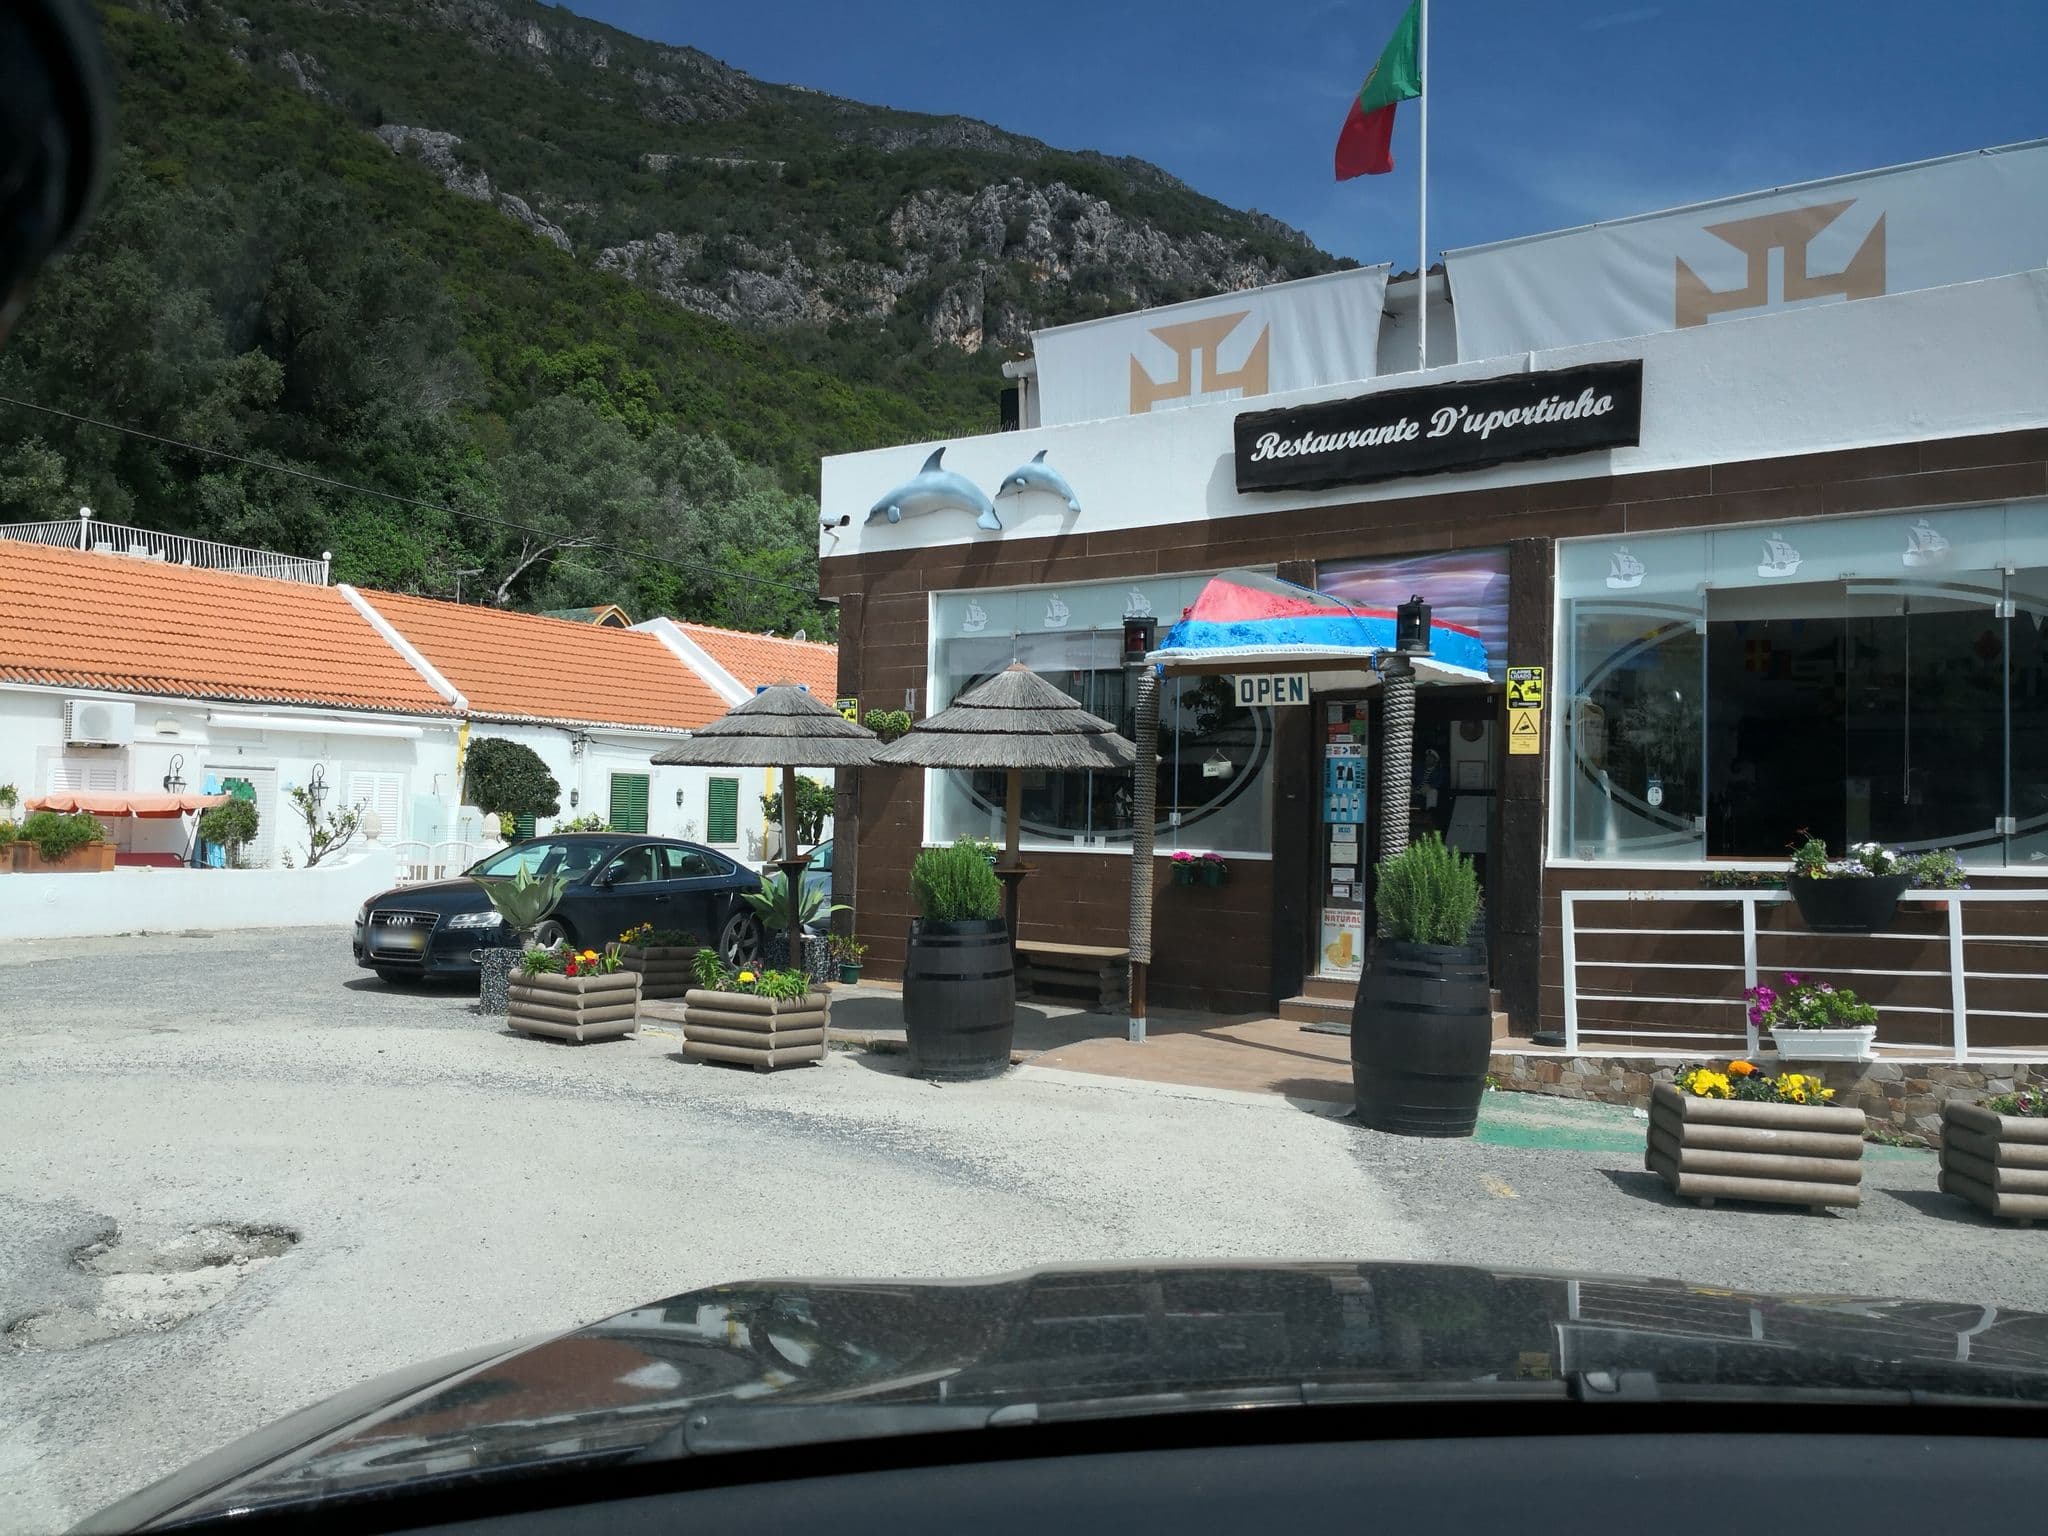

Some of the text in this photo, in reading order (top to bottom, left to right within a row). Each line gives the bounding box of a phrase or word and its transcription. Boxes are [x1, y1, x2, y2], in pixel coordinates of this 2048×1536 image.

[1250, 387, 1613, 462] Restaurante D'uportinho
[1241, 677, 1303, 703] OPEN
